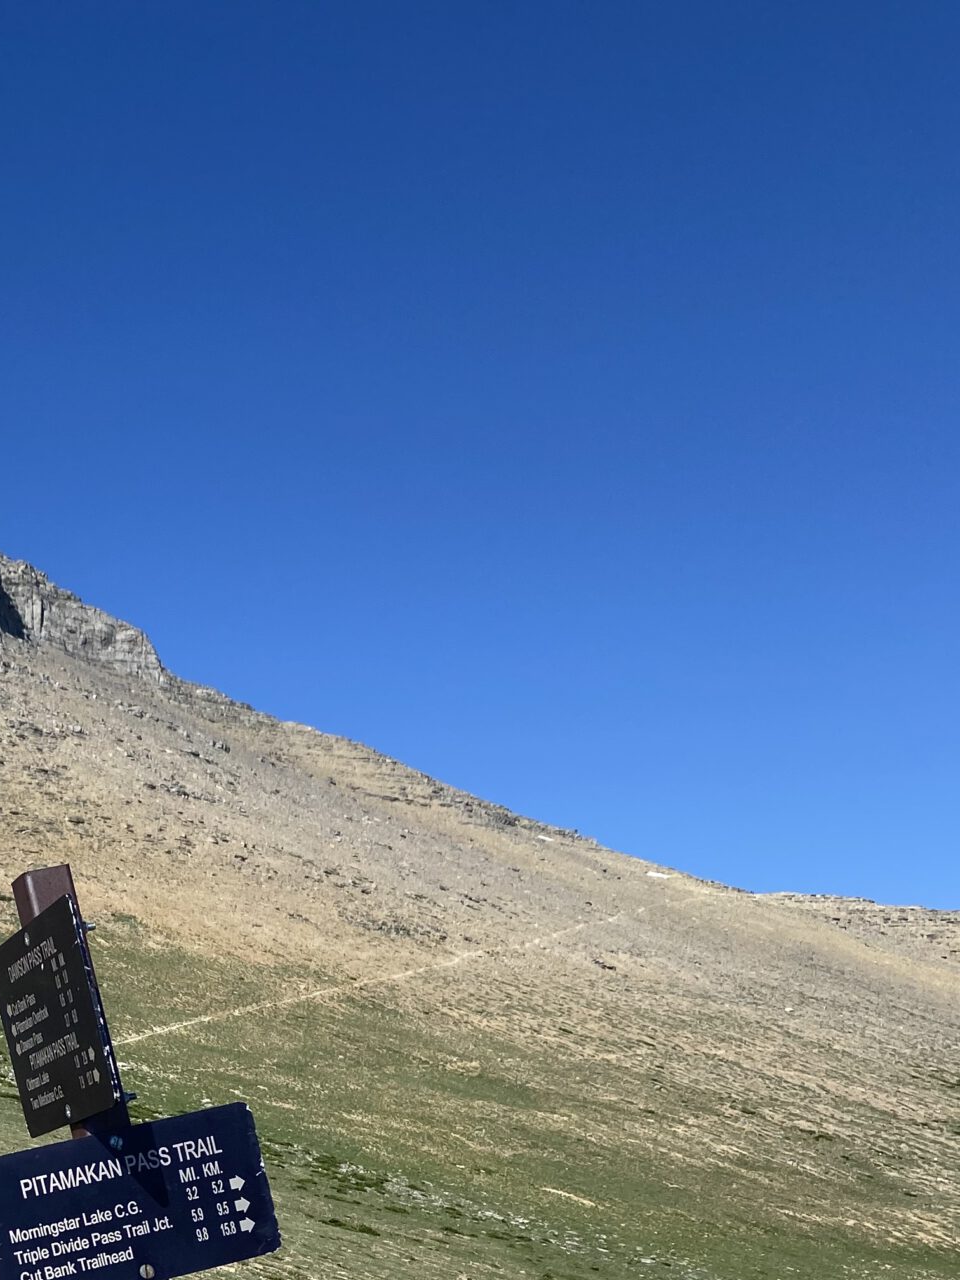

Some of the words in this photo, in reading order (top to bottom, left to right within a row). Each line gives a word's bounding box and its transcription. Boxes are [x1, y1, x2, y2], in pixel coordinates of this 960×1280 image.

[28, 946, 43, 970] PASS
[40, 936, 57, 960] TRAIL
[29, 1044, 54, 1071] PITAMAKAN
[51, 1037, 67, 1060] PASS
[64, 1031, 80, 1053] TRAIL
[20, 1158, 123, 1199] PITAMAKAN
[124, 1146, 172, 1175] PASS
[172, 1135, 223, 1162] TRAIL
[179, 1166, 200, 1183] MI.
[202, 1160, 224, 1177] KM.
[9, 1217, 80, 1244] Morningstar
[82, 1209, 113, 1226] Lake
[114, 1200, 143, 1218] C.G.
[186, 1186, 200, 1200] 3.2
[211, 1179, 225, 1194] 5.2
[14, 1246, 50, 1265] Triple
[51, 1236, 90, 1256] Divide
[91, 1229, 123, 1247] Pass
[123, 1219, 151, 1239] Trail
[152, 1216, 174, 1232] Jct.
[191, 1207, 204, 1222] 5.9
[216, 1201, 230, 1216] 9.5
[44, 1261, 77, 1280] Bank
[77, 1246, 135, 1272] Trailhead
[196, 1227, 209, 1242] 9.8
[220, 1221, 237, 1237] 15.8
